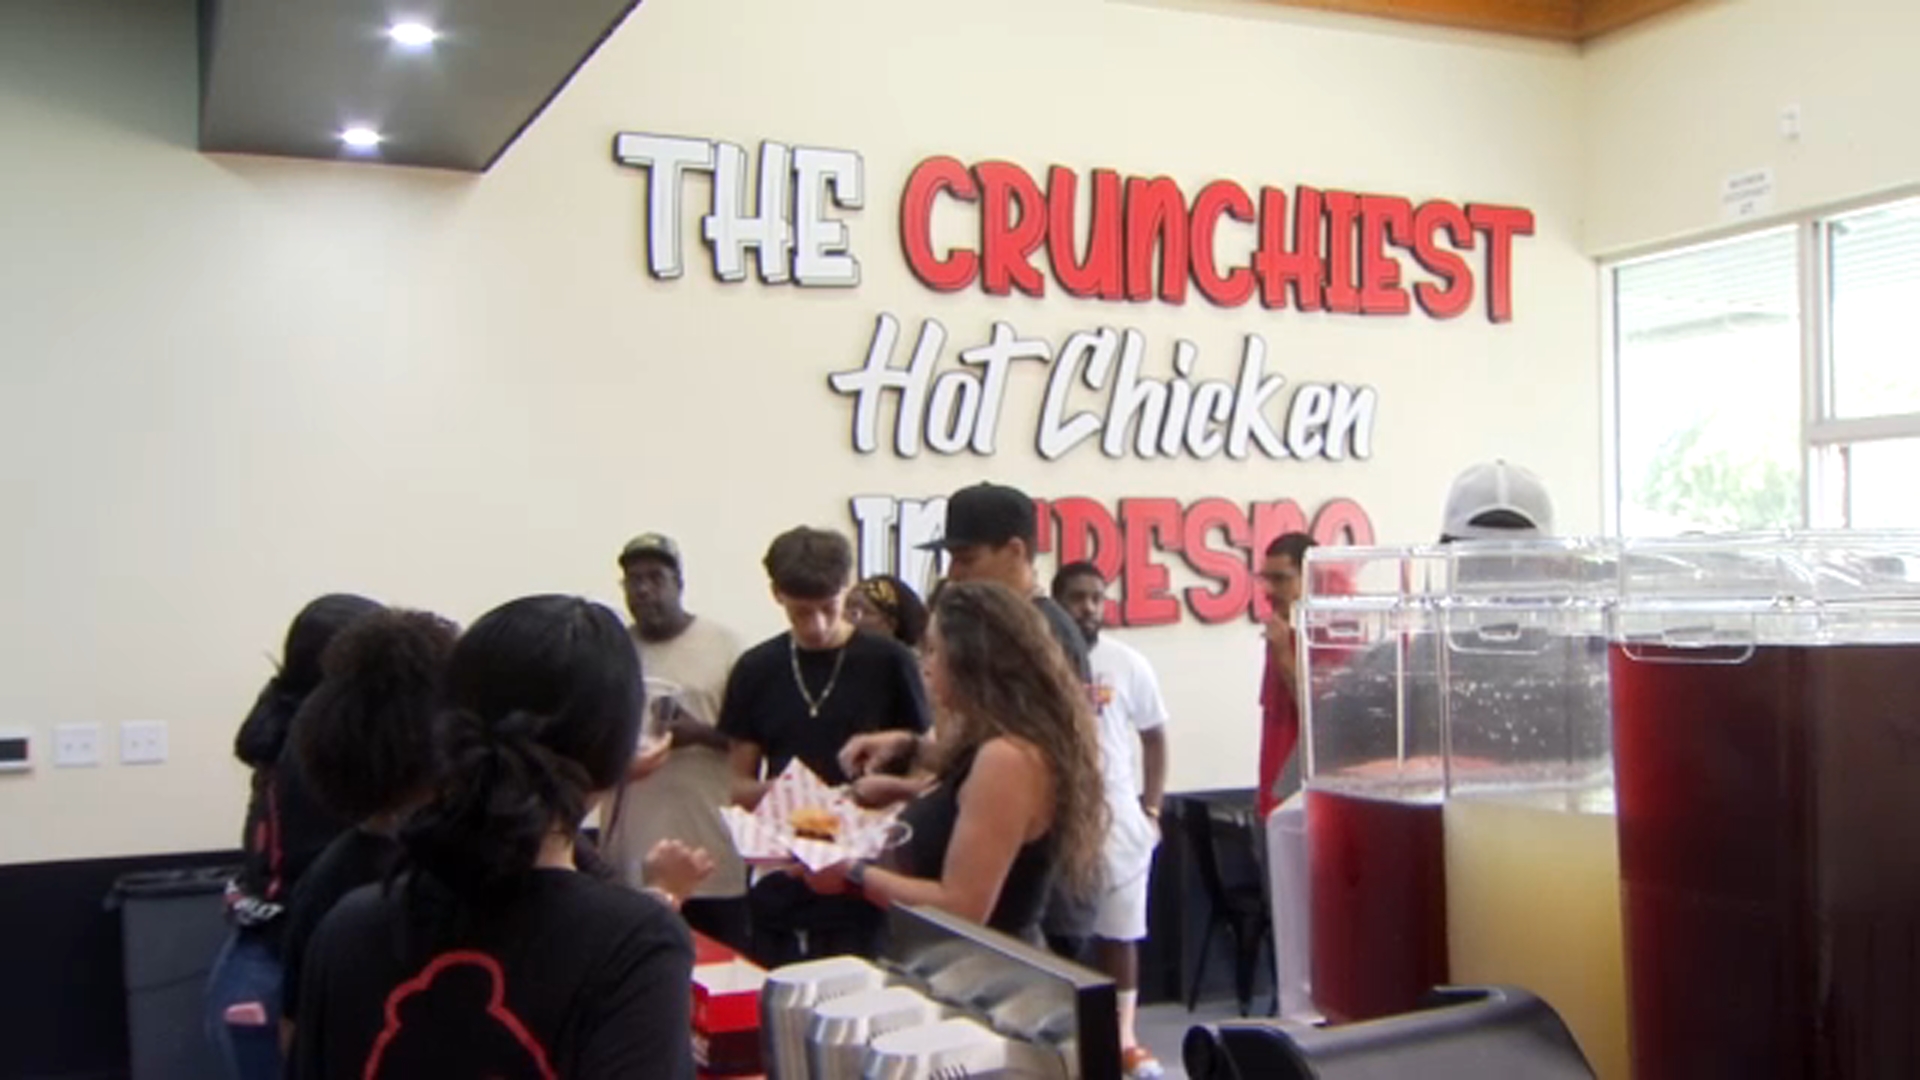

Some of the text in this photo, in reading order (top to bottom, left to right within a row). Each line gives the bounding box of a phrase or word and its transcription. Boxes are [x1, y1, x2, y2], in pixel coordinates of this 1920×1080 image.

[613, 131, 1534, 322] THE CRUNCHIEST
[829, 313, 1378, 461] Hot Chicken
